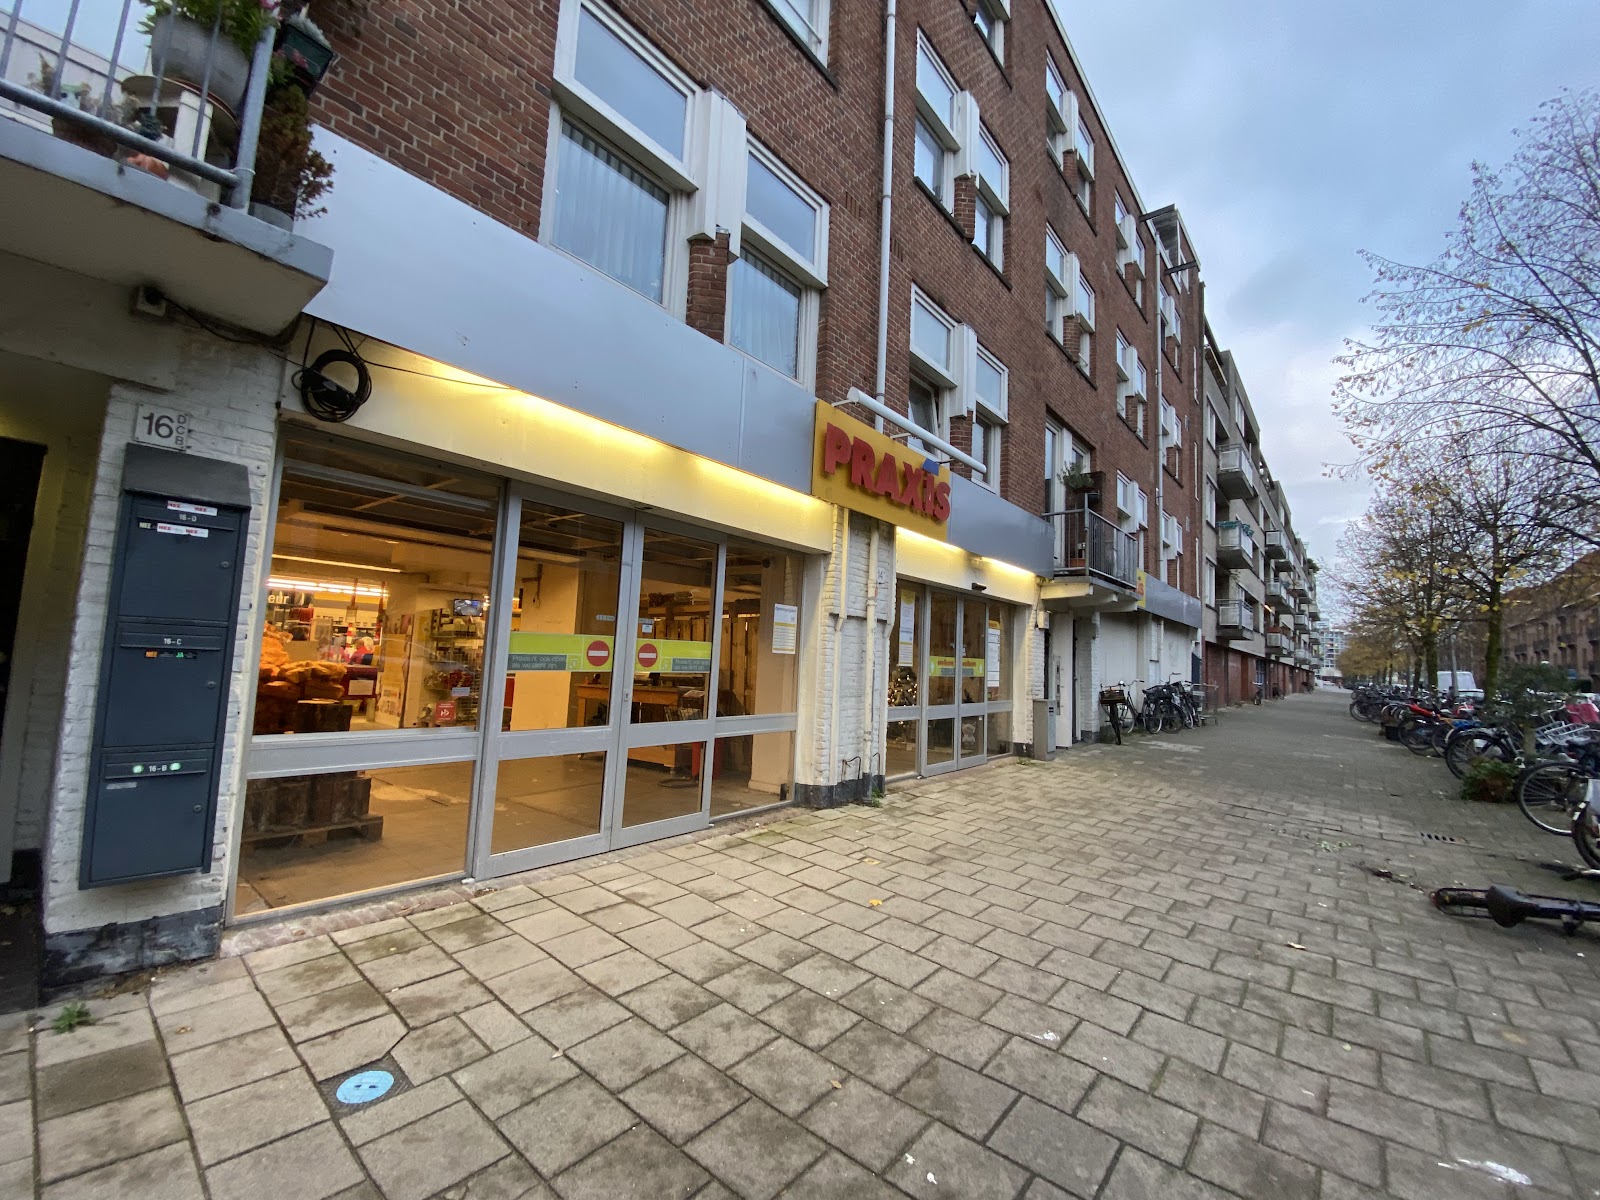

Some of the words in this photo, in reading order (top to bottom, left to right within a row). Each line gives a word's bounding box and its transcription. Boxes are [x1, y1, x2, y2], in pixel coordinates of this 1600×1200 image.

[177, 414, 187, 425] D
[142, 412, 174, 439] 16
[176, 425, 186, 435] C
[175, 435, 184, 446] B
[824, 422, 951, 521] PRAXIS
